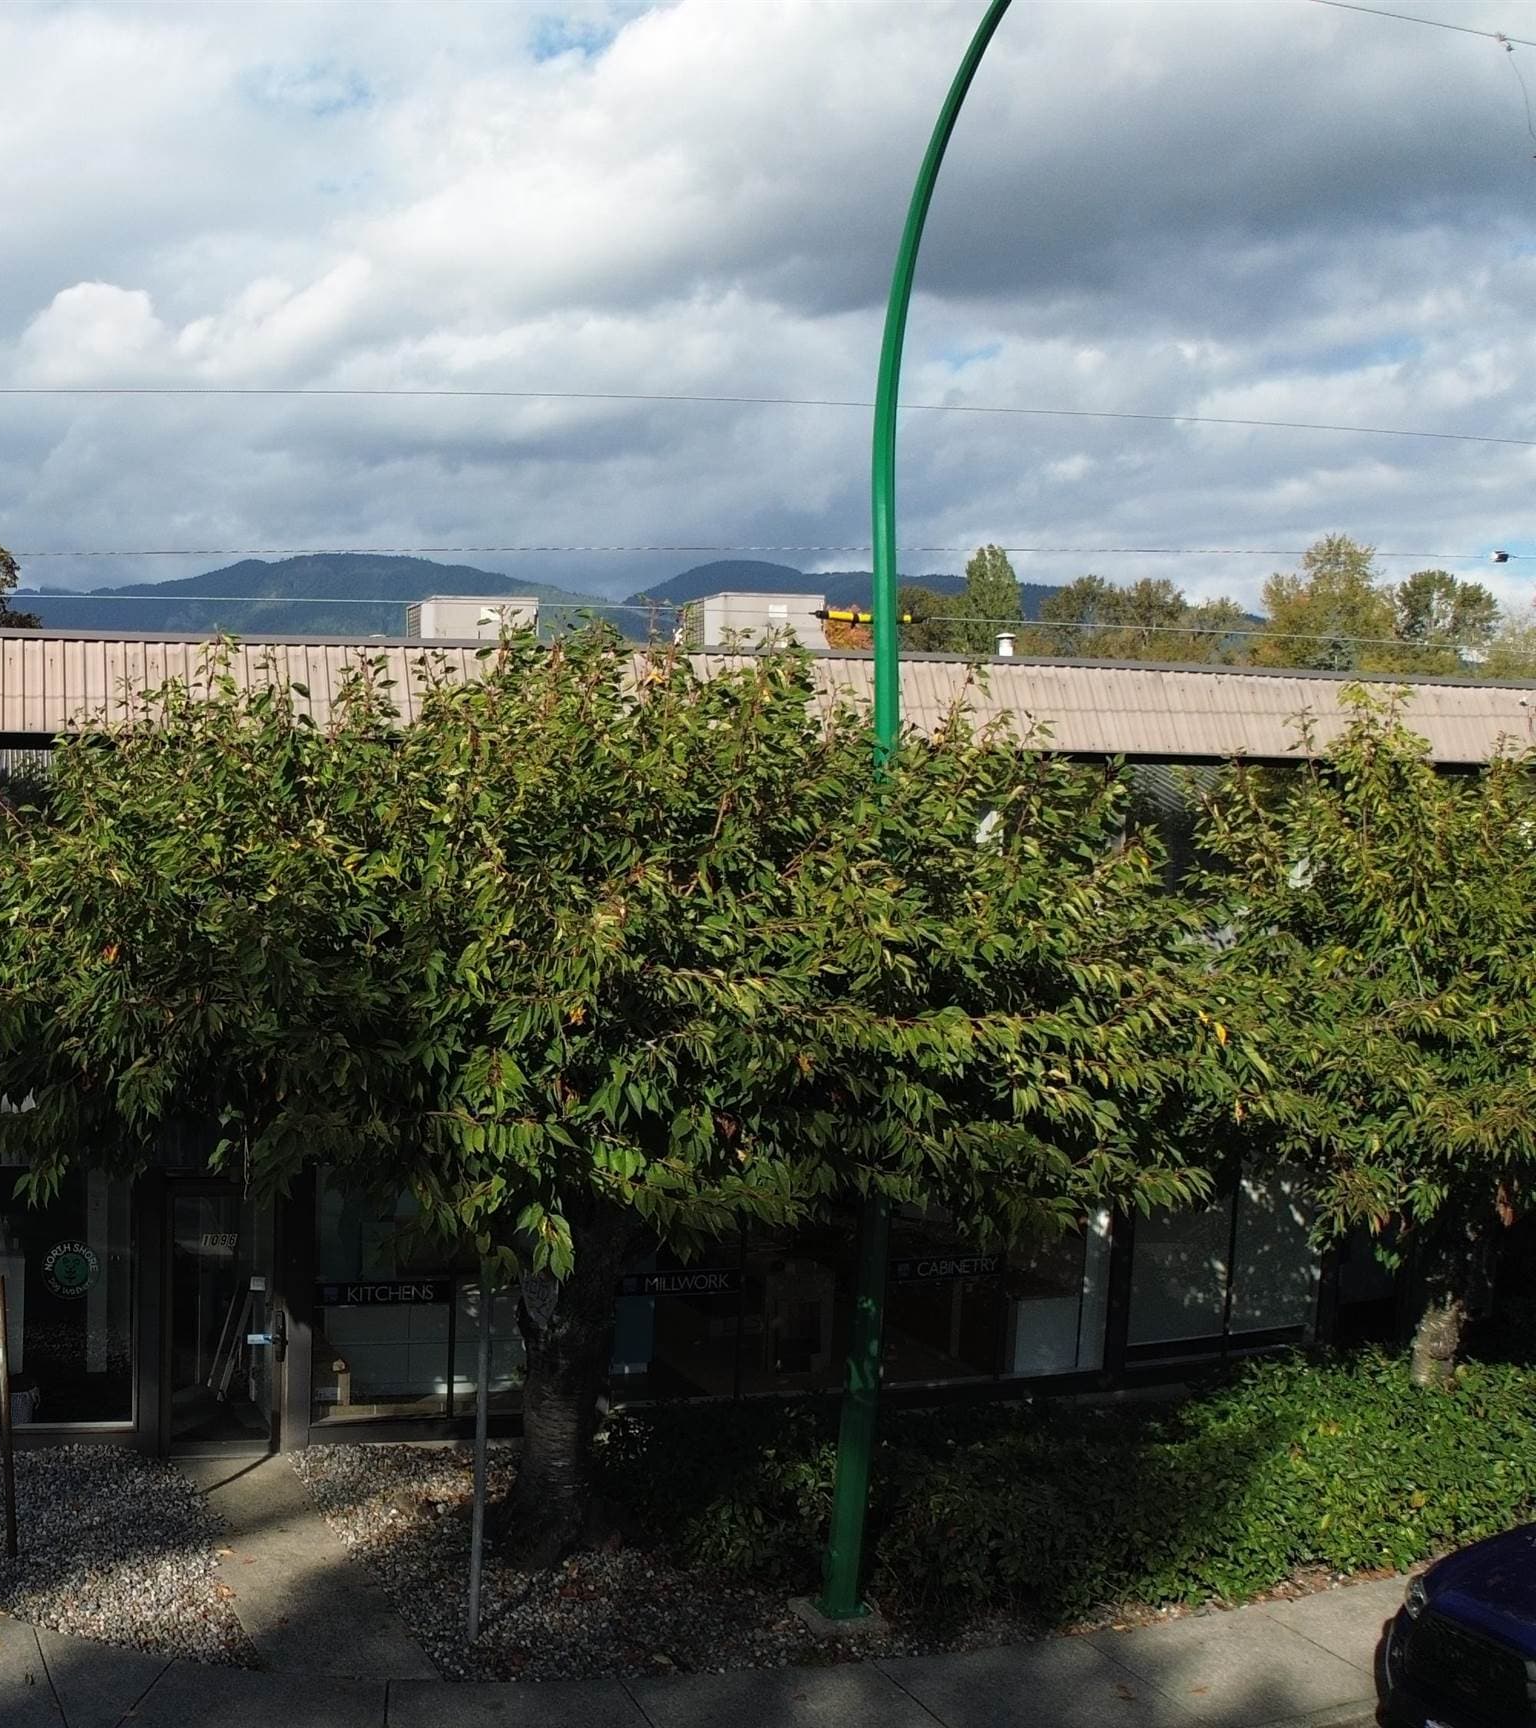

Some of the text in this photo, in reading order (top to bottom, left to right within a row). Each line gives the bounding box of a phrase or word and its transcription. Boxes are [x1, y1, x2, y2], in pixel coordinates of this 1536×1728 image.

[202, 1234, 237, 1247] 1096
[44, 1243, 98, 1272] NORTH SHORE
[917, 1257, 999, 1277] CABINETRY
[644, 1273, 729, 1293] MILLWORK
[346, 1284, 434, 1303] KITCHENS
